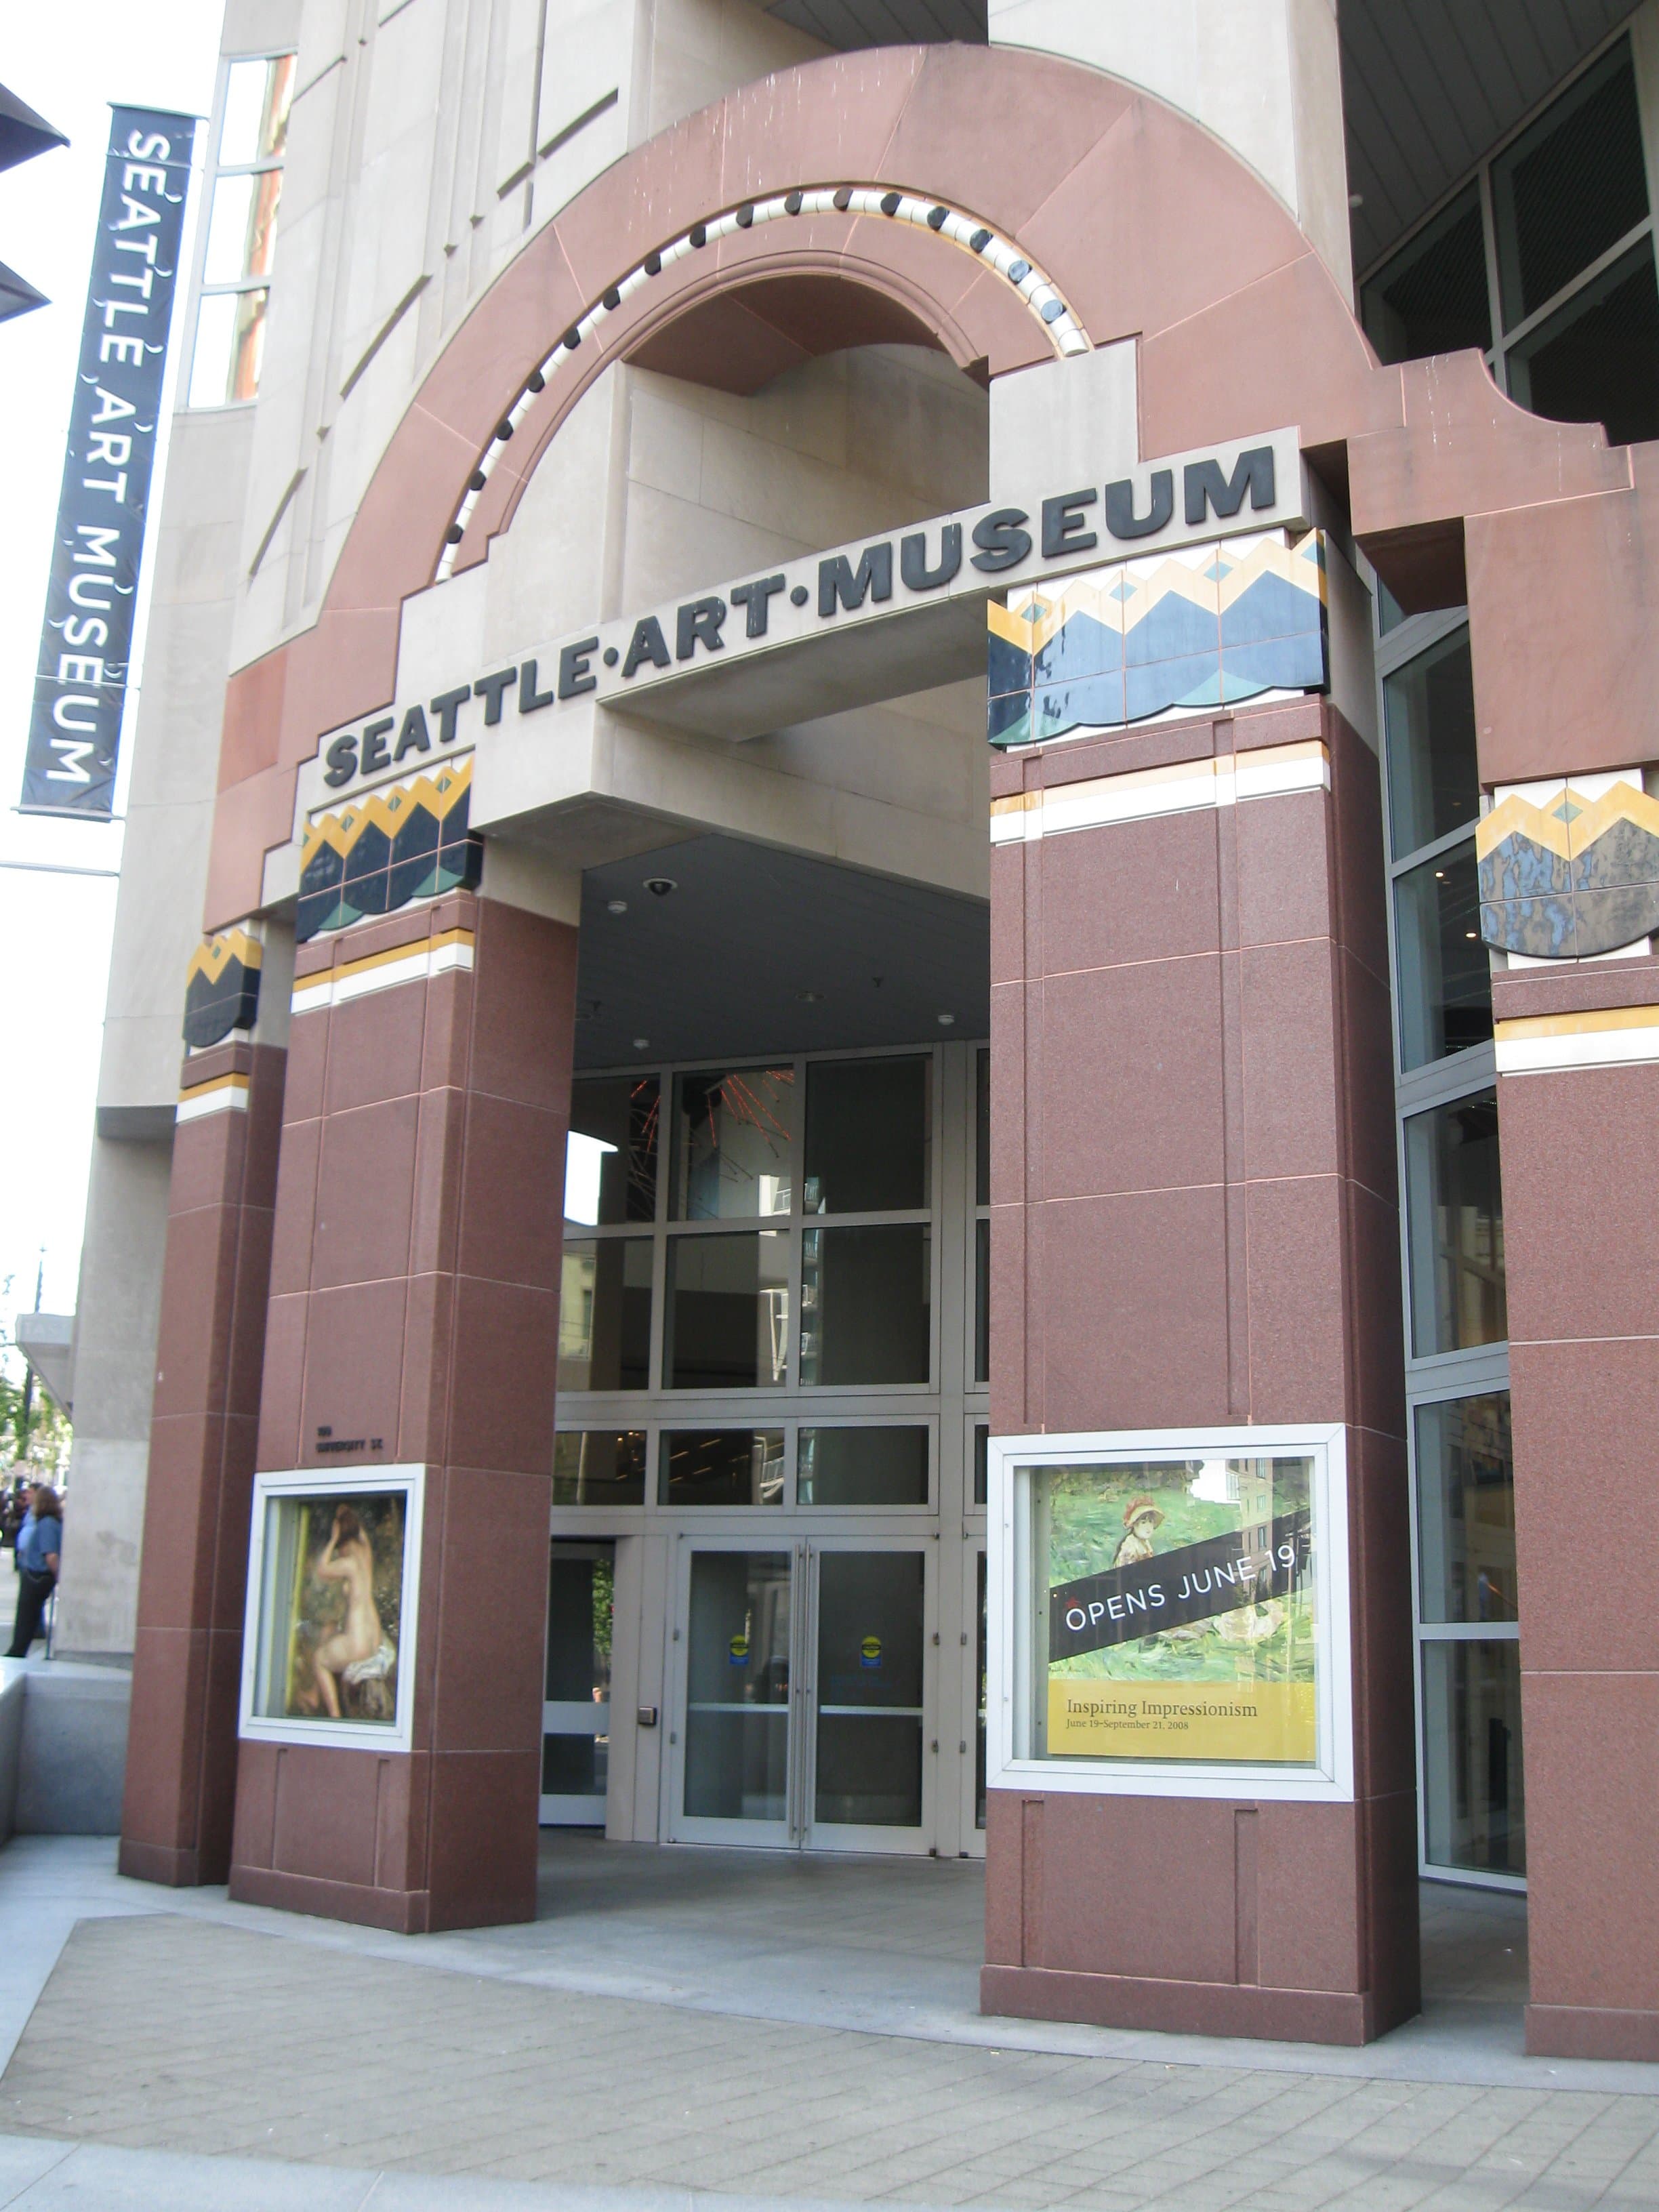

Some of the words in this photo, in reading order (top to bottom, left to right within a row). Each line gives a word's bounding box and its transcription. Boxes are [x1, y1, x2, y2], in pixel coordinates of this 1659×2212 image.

[100, 129, 171, 367] SEATTLE
[82, 386, 136, 504] ART
[45, 525, 121, 784] MUSEUM
[323, 635, 598, 788] SEATTLE
[621, 573, 786, 678] ART
[817, 445, 1275, 617] MUSEUM
[1065, 1584, 1166, 1631] OPENS
[1177, 1556, 1256, 1599] JUNE
[1265, 1544, 1296, 1572] 19
[1066, 1719, 1086, 1729] June
[1168, 1721, 1189, 1730] 2008
[1067, 1699, 1137, 1717] Inspiring
[1142, 1700, 1258, 1719] Impressionism
